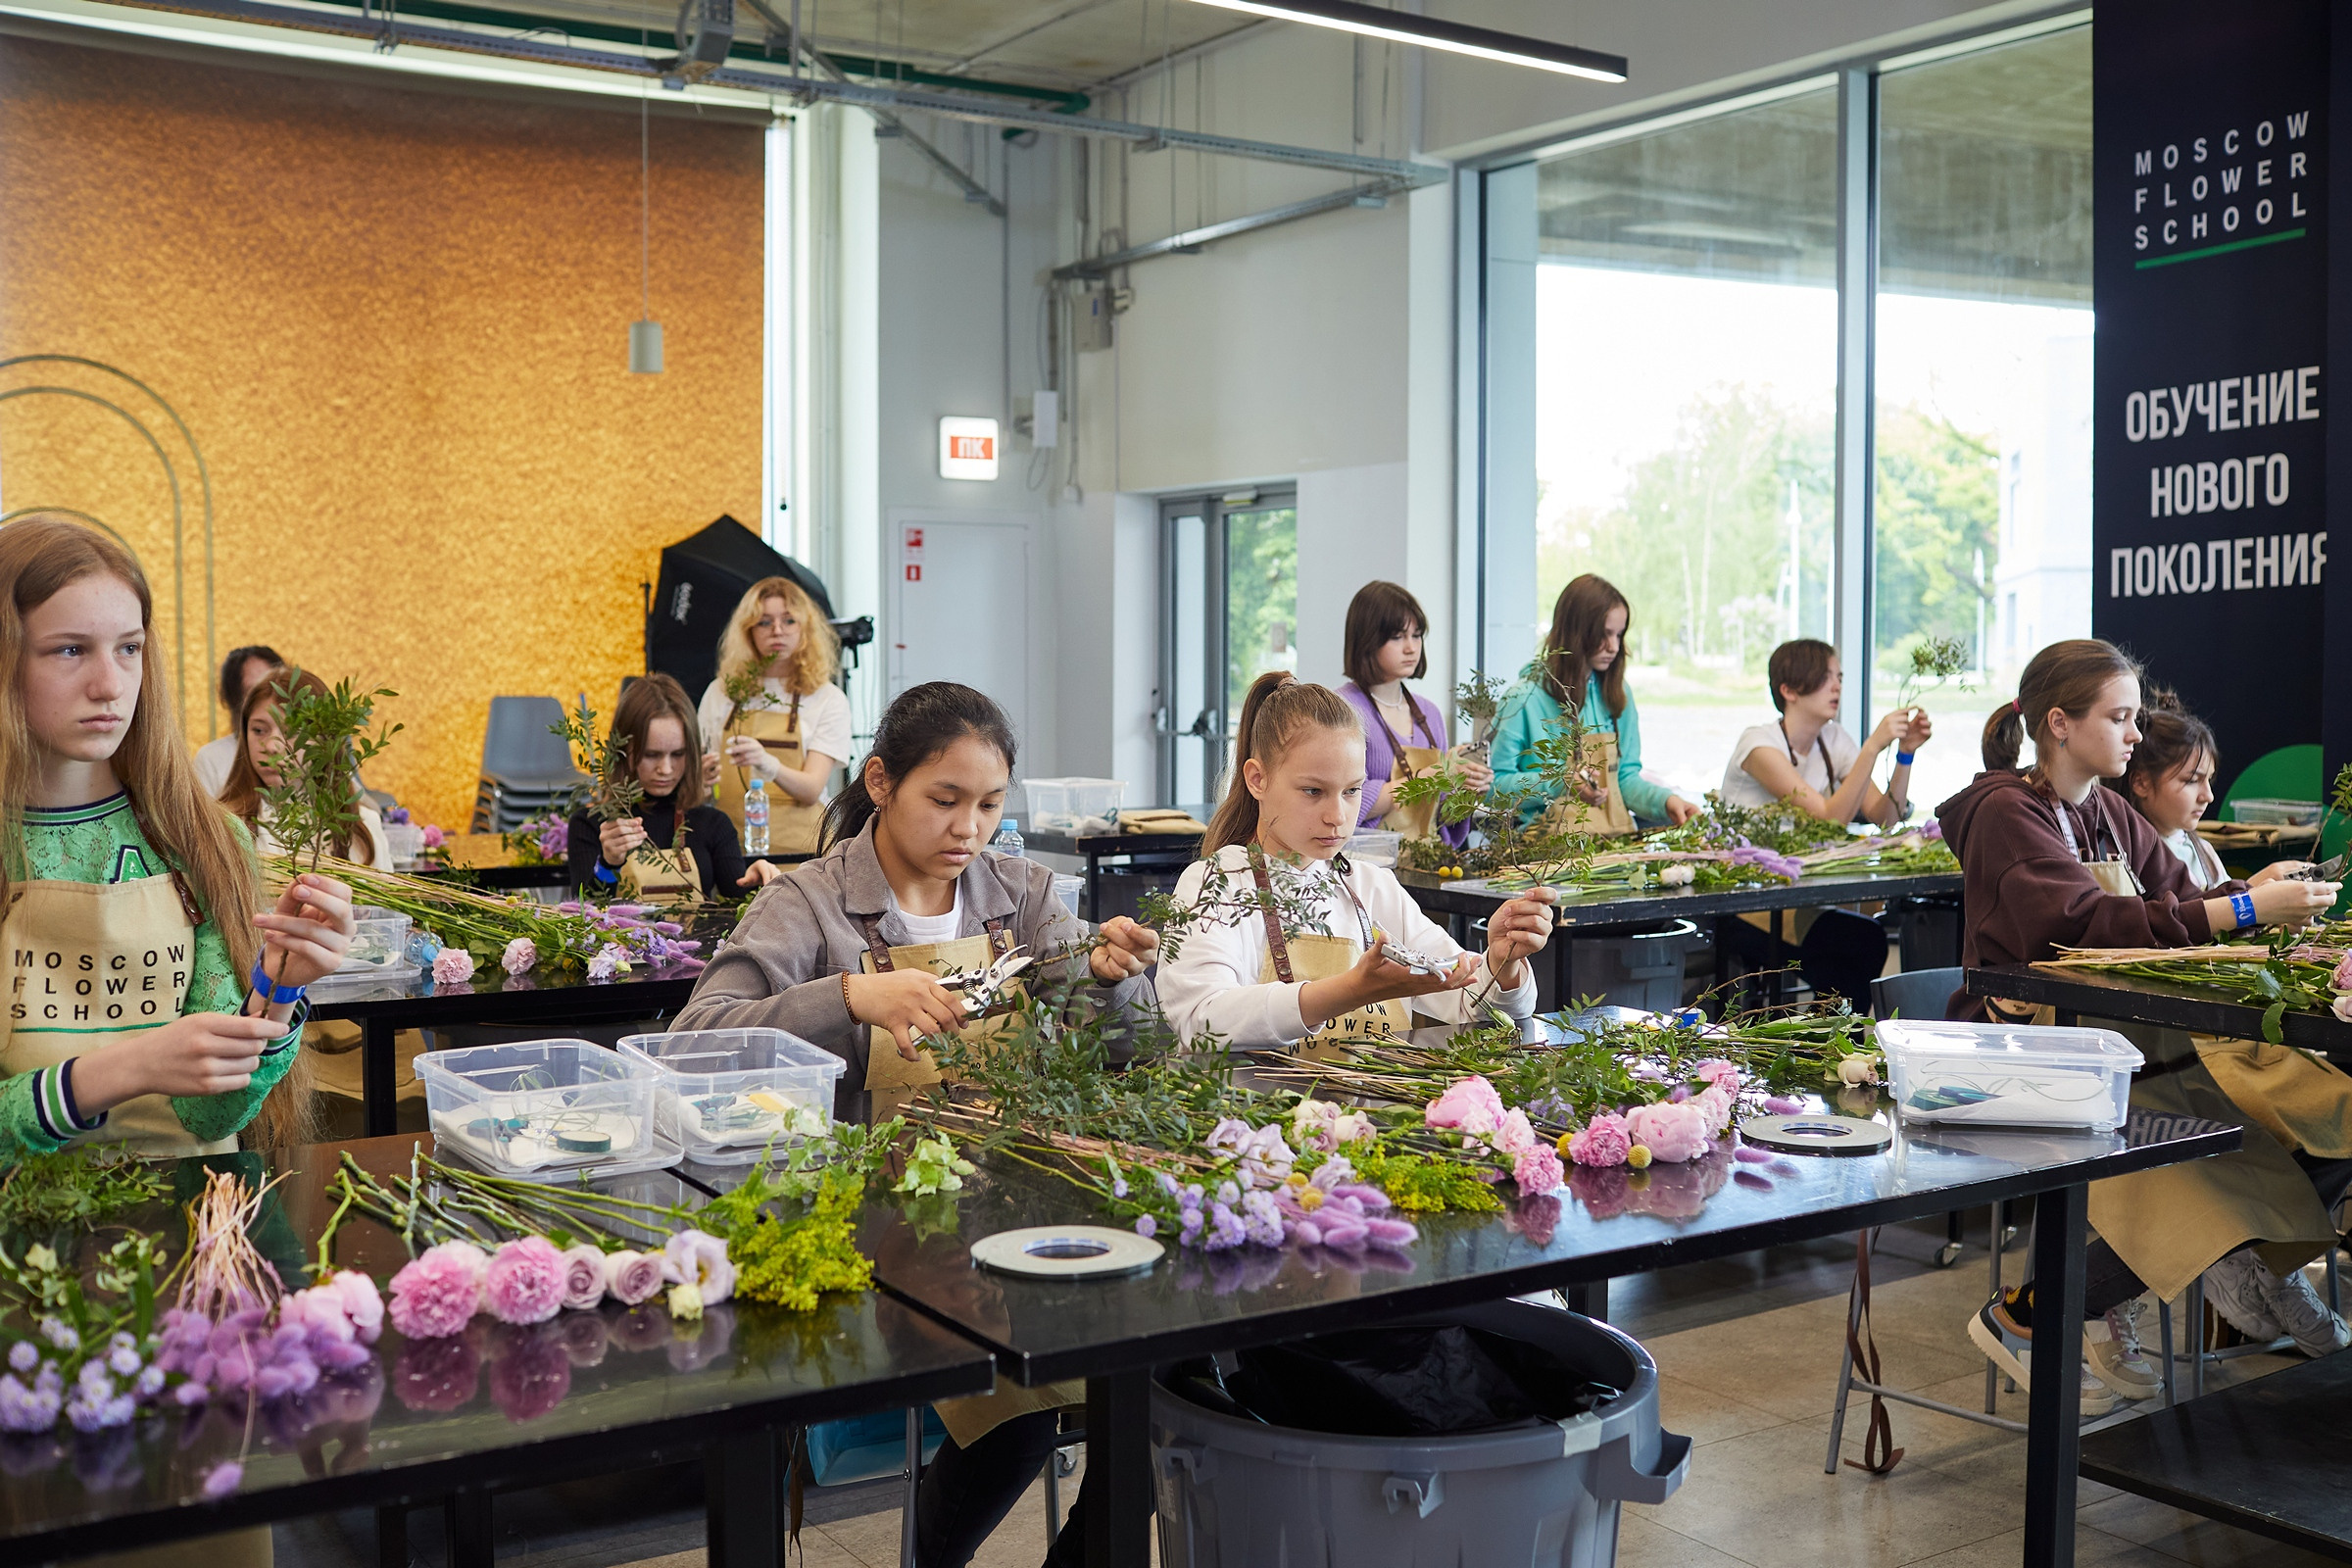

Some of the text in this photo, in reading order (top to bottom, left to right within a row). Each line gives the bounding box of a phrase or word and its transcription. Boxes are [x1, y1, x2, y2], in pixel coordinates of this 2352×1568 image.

[2134, 111, 2310, 177] MOSCOW
[2134, 152, 2307, 215] FLOWER
[2134, 192, 2307, 250] SCHOOL
[2125, 366, 2321, 443] ОБУЧЕНИЕ
[2150, 452, 2289, 518] НОВОГО
[13, 971, 186, 996] FLOWER
[15, 944, 185, 971] MOSCOW
[10, 997, 182, 1021] SCHOOL
[1325, 1017, 1391, 1035] OWER
